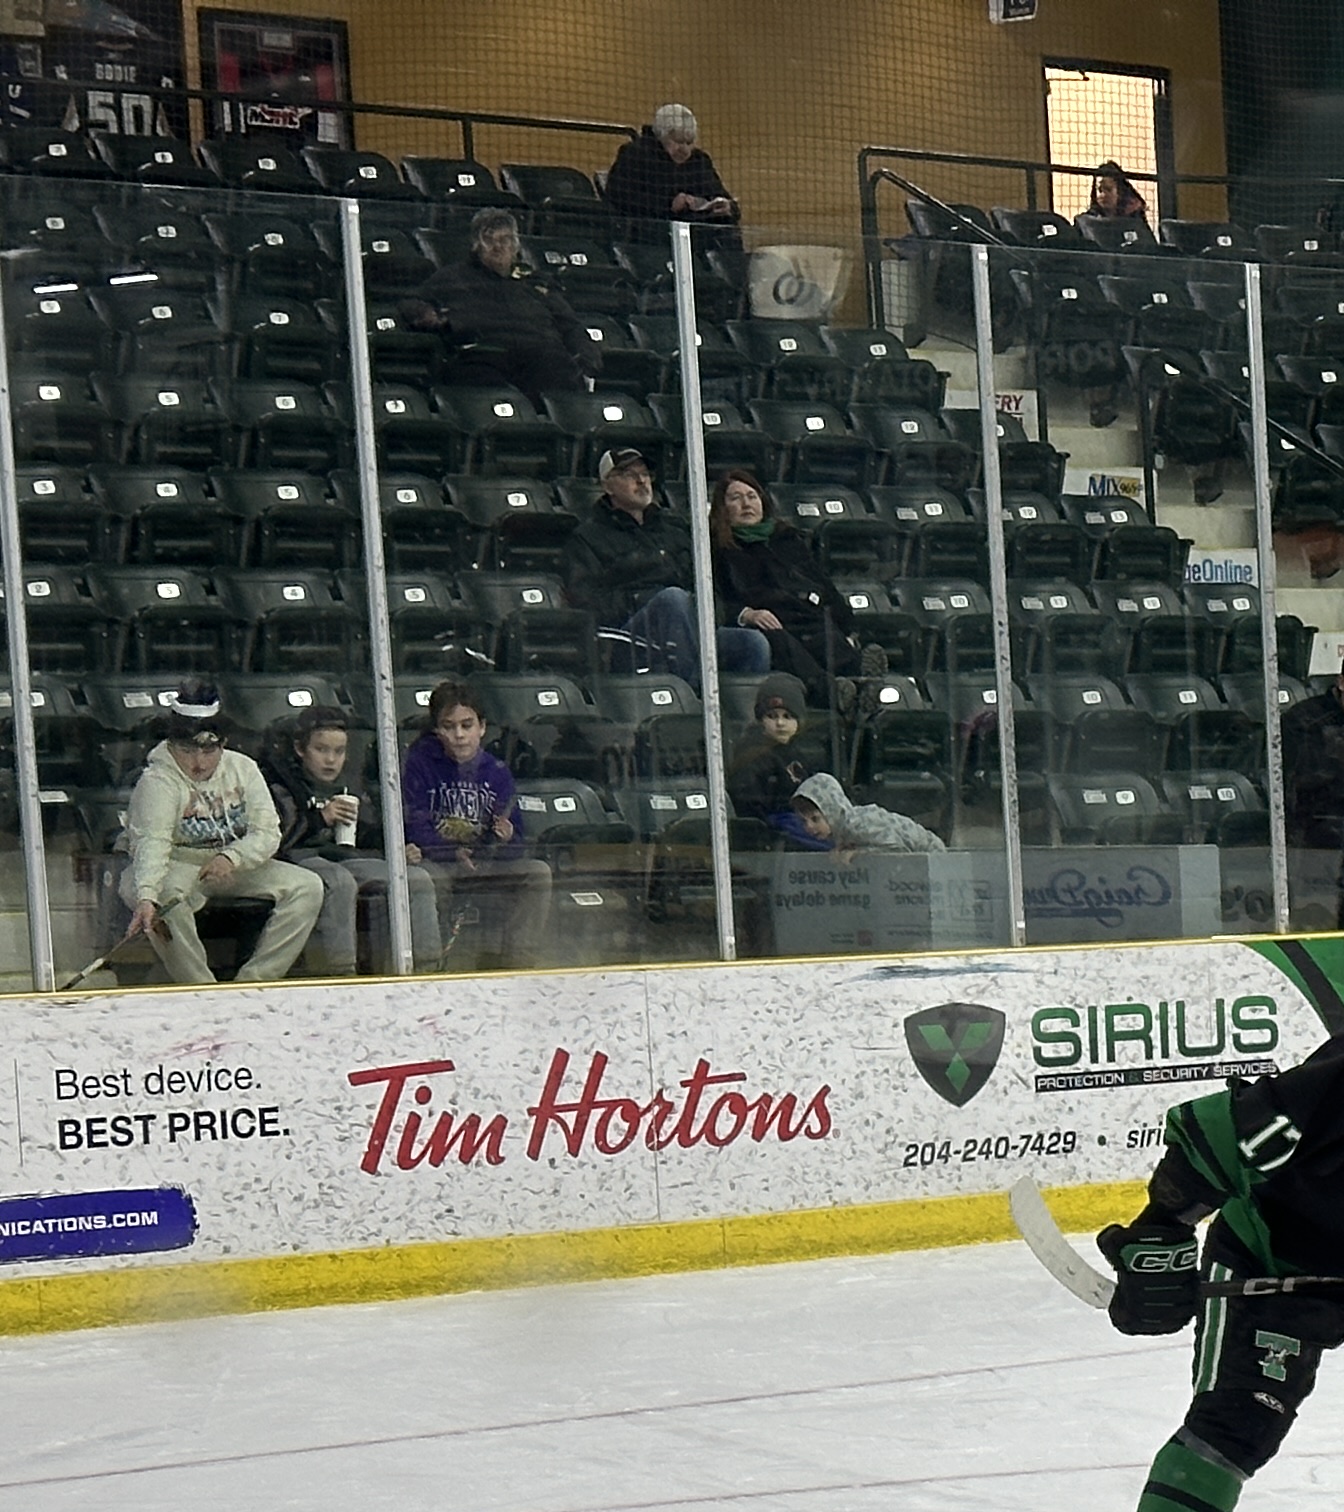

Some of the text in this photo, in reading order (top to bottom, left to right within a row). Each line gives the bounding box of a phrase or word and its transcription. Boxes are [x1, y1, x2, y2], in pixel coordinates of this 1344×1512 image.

[86, 91, 152, 136] 50
[994, 394, 1024, 411] FRY
[1088, 474, 1121, 497] MIX
[1030, 994, 1280, 1069] SIRIUS
[55, 1061, 262, 1100] Best device.
[1036, 1073, 1125, 1091] PROTECTION
[1142, 1065, 1209, 1084] SECURITY
[1213, 1061, 1278, 1078] SERVICES
[57, 1106, 290, 1150] BEST PRICE.
[347, 1046, 832, 1176] Tim Hortons
[903, 1130, 1077, 1168] 204-240-7429
[1129, 1243, 1199, 1274] CC
